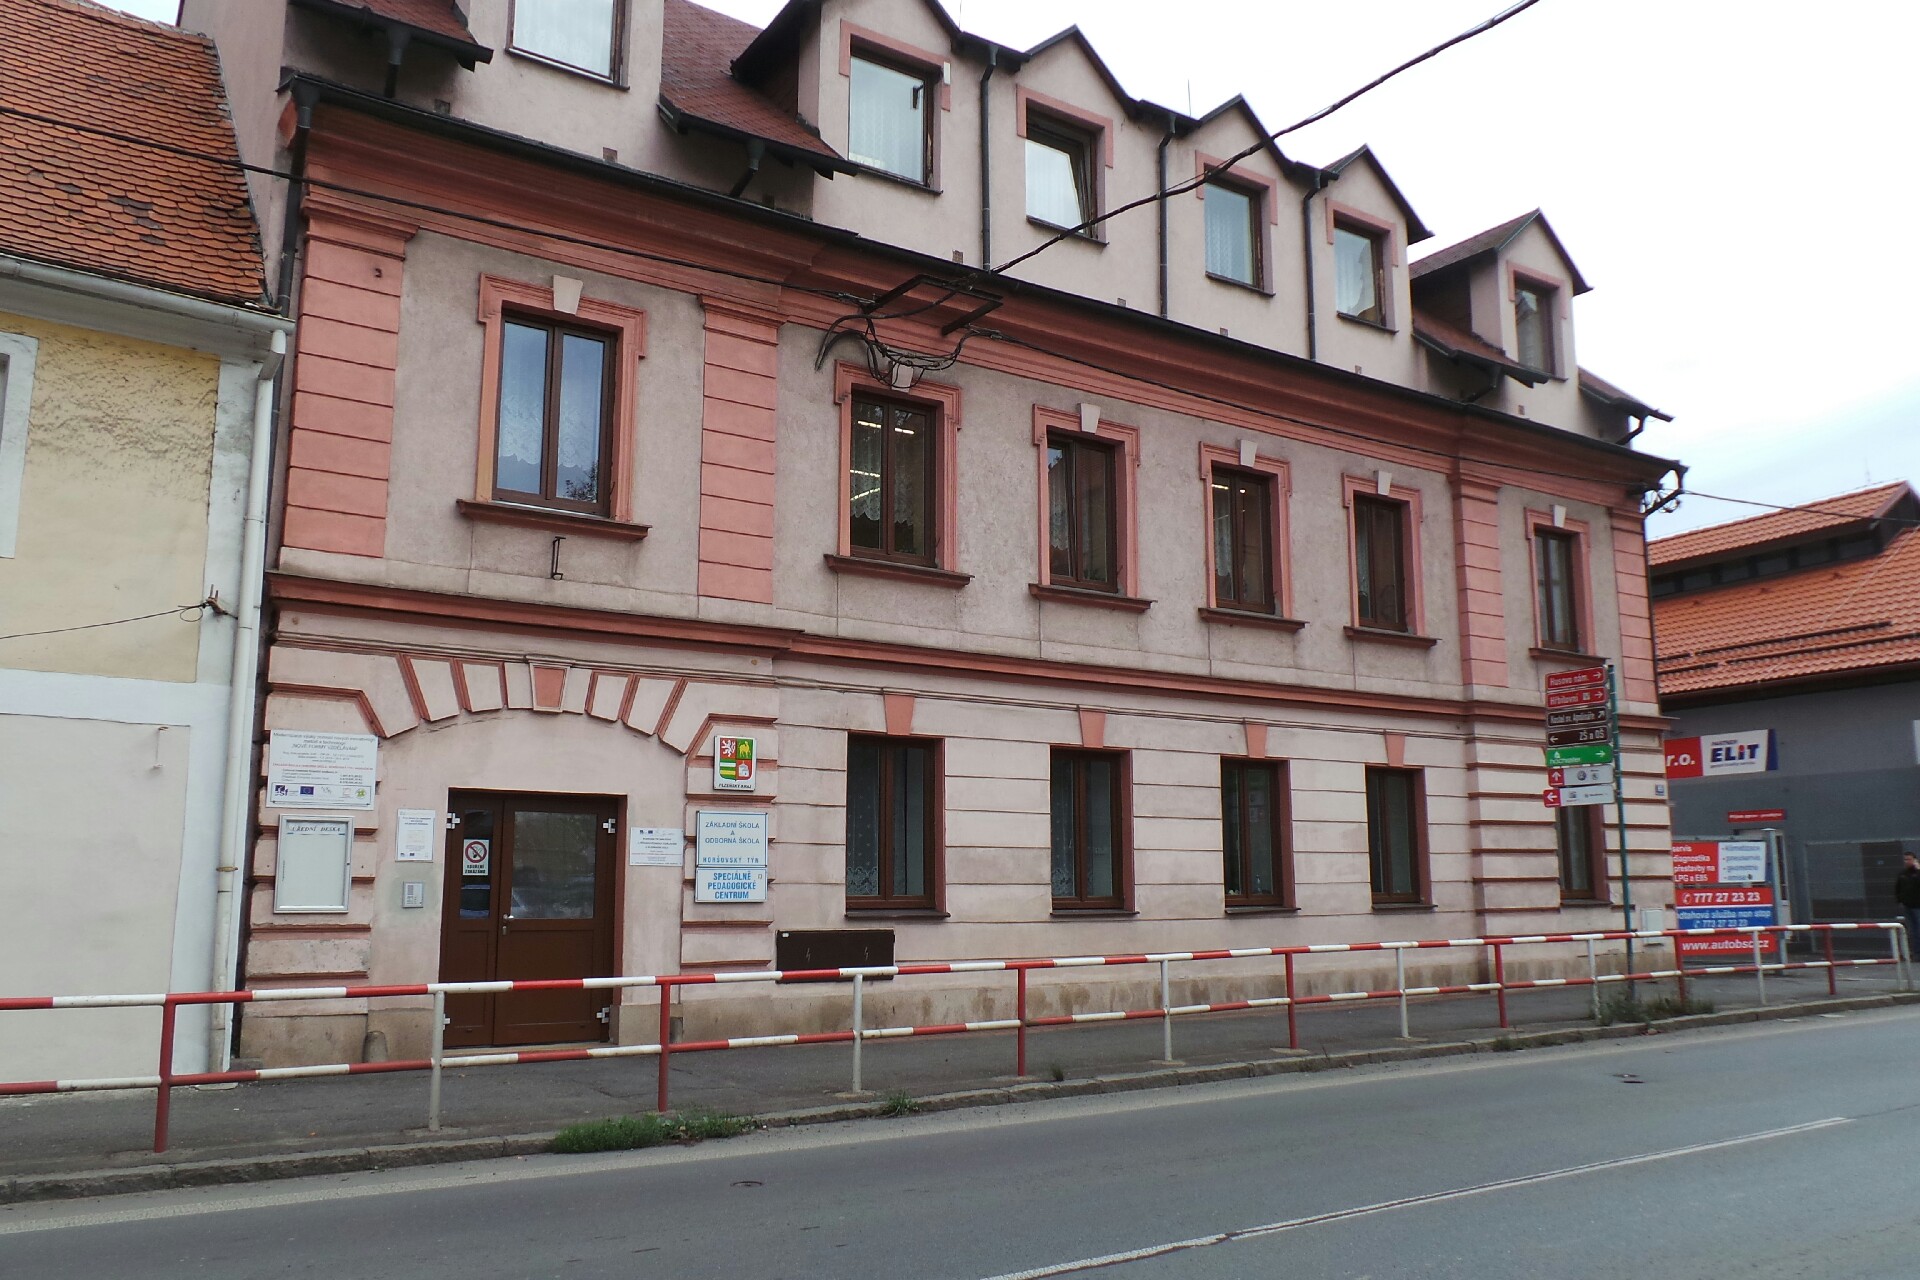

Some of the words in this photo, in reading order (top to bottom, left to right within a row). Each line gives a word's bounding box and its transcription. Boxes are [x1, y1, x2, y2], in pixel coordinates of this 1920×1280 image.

[1580, 730, 1588, 740] ZŠ
[1595, 728, 1605, 739] OŠ
[705, 820, 737, 828] ZÁKLADNÍ
[738, 820, 760, 828] ŠKOLA
[702, 856, 742, 864] HORŠOVSKÝ
[747, 856, 759, 864] TÝN
[1674, 874, 1689, 882] LPG
[708, 880, 756, 890] PEDAGOGICKÉ
[714, 891, 750, 899] CENTRUM
[1694, 892, 1713, 903] 777
[1716, 892, 1729, 903] 27
[1732, 892, 1746, 902] 23
[1748, 892, 1760, 902] 23
[1678, 910, 1710, 920] dtahová
[1711, 910, 1736, 918] služba
